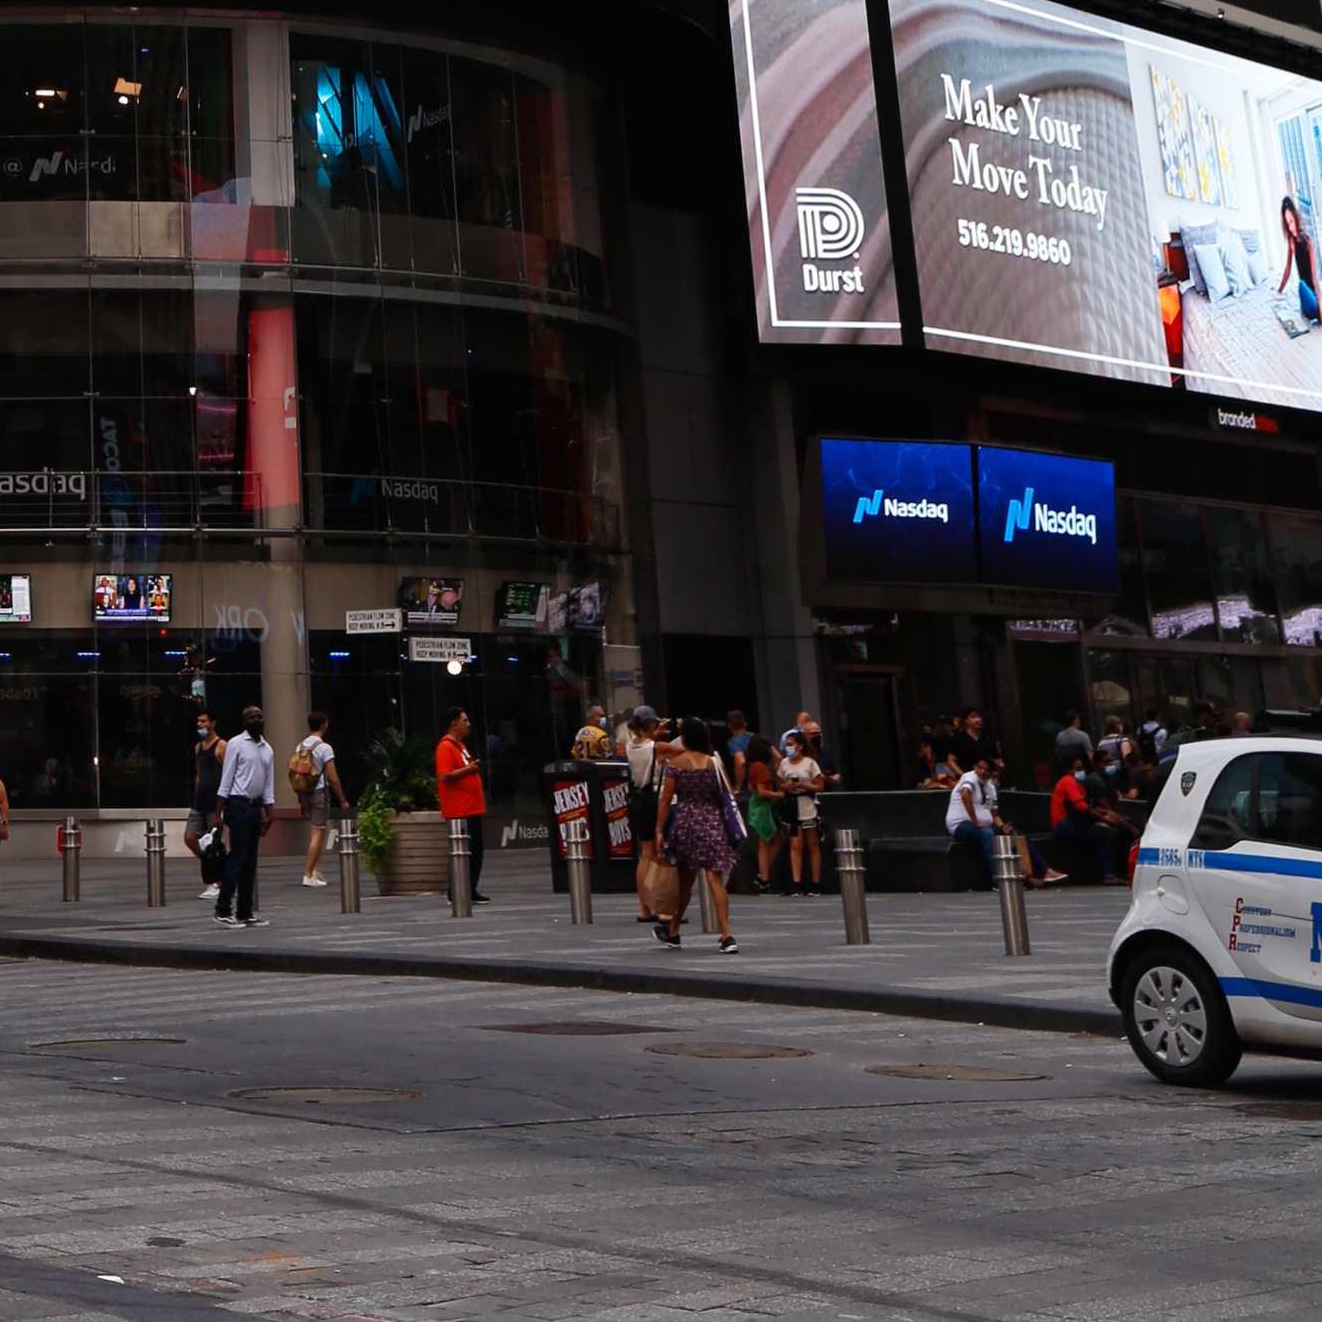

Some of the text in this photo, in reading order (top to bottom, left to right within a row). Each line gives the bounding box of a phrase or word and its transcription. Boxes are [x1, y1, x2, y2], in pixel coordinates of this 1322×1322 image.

[940, 73, 1083, 151] Make Your
[948, 137, 1109, 232] Move Today
[957, 217, 1072, 266] 516.219.9860
[802, 263, 865, 293] Durst
[381, 478, 439, 506] Nasdaq
[884, 498, 949, 523] Nasdaq
[1034, 503, 1097, 544] Nasdaq
[553, 781, 590, 815] JERSEY
[607, 816, 632, 847] BOYS
